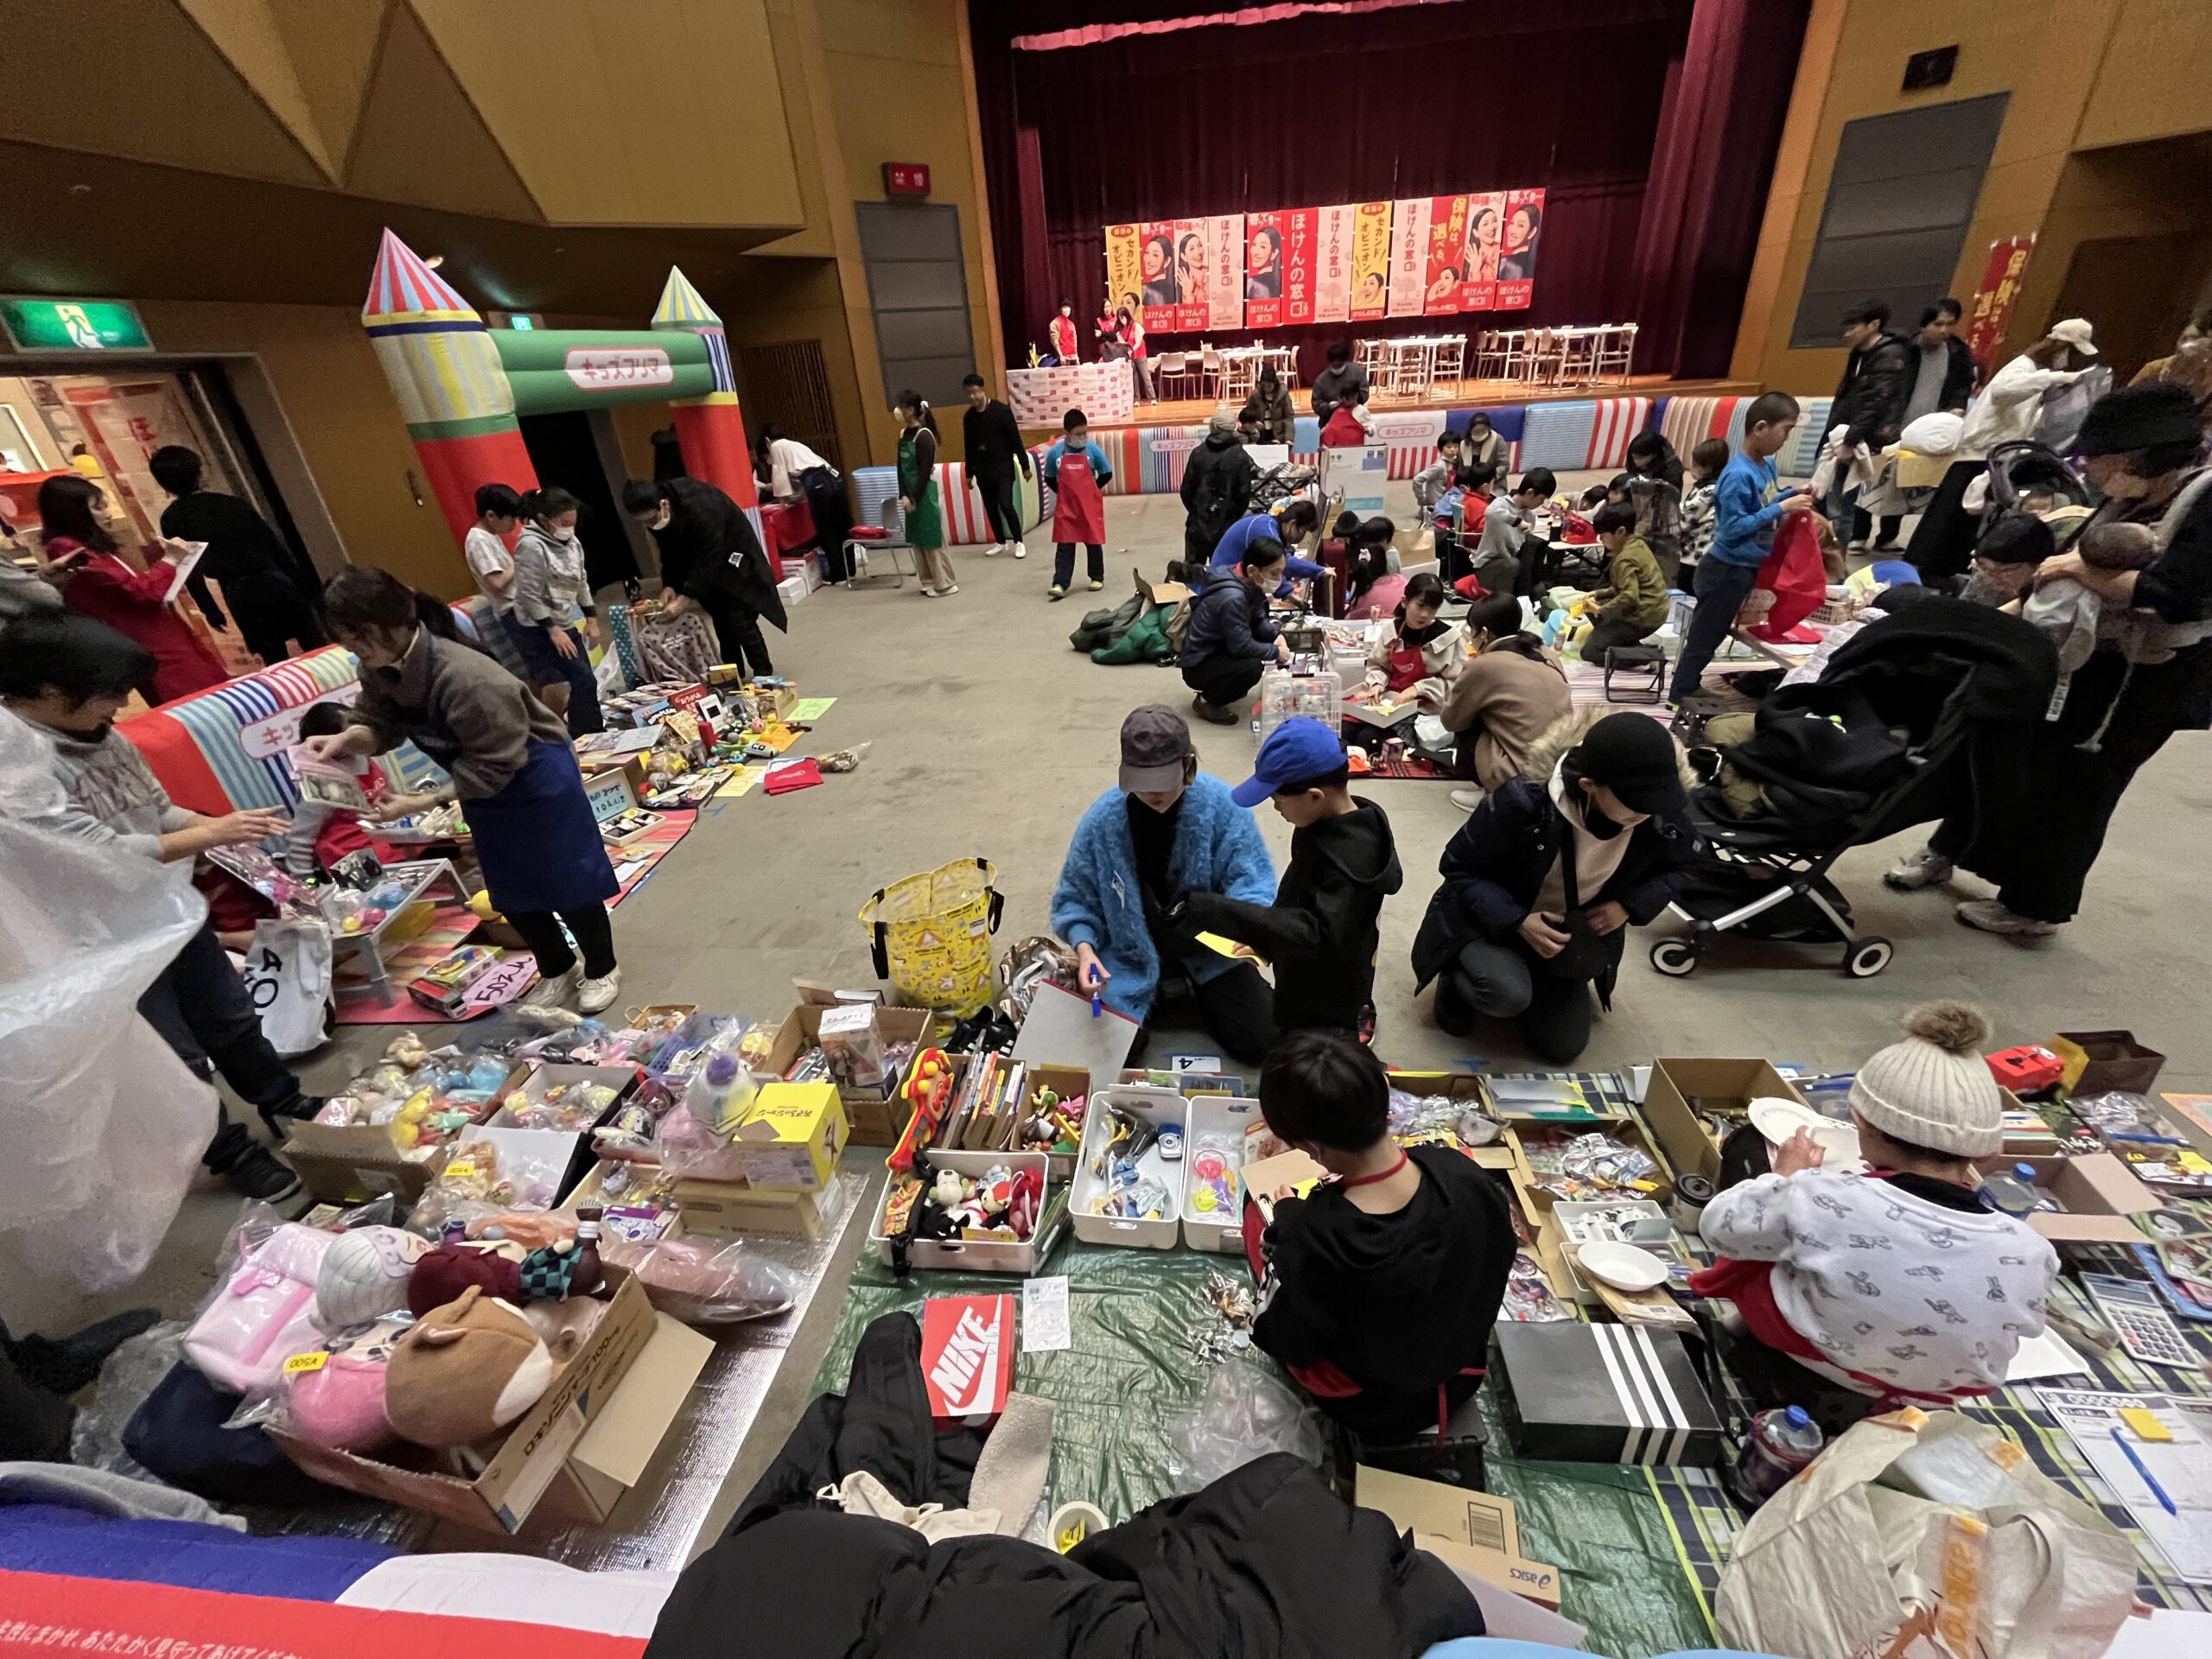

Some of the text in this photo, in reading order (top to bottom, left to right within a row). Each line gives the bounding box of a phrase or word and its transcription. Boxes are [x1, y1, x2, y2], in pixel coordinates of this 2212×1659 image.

[1329, 210, 1341, 278] ほけんの窓口
[1374, 216, 1386, 257] セカンド
[1404, 204, 1417, 271] ほけんの窓口
[1126, 238, 1135, 279] セカンド
[1221, 219, 1231, 287] ほけんの窓口
[1289, 213, 1306, 317] ほけんの窓口
[1463, 286, 1492, 297] ほけんの
[1500, 285, 1529, 296] ほけんの
[1145, 310, 1173, 319] ほけんの
[1178, 308, 1206, 318] ほけんの
[1249, 303, 1278, 314] ほけんの
[581, 355, 659, 380] キッズフリマ
[1156, 441, 1196, 449] キッズフリマ
[1179, 1057, 1193, 1070] 4
[755, 1108, 813, 1118] おさるのジョージ
[930, 1305, 997, 1404] NIKE
[1510, 1568, 1538, 1584] asics
